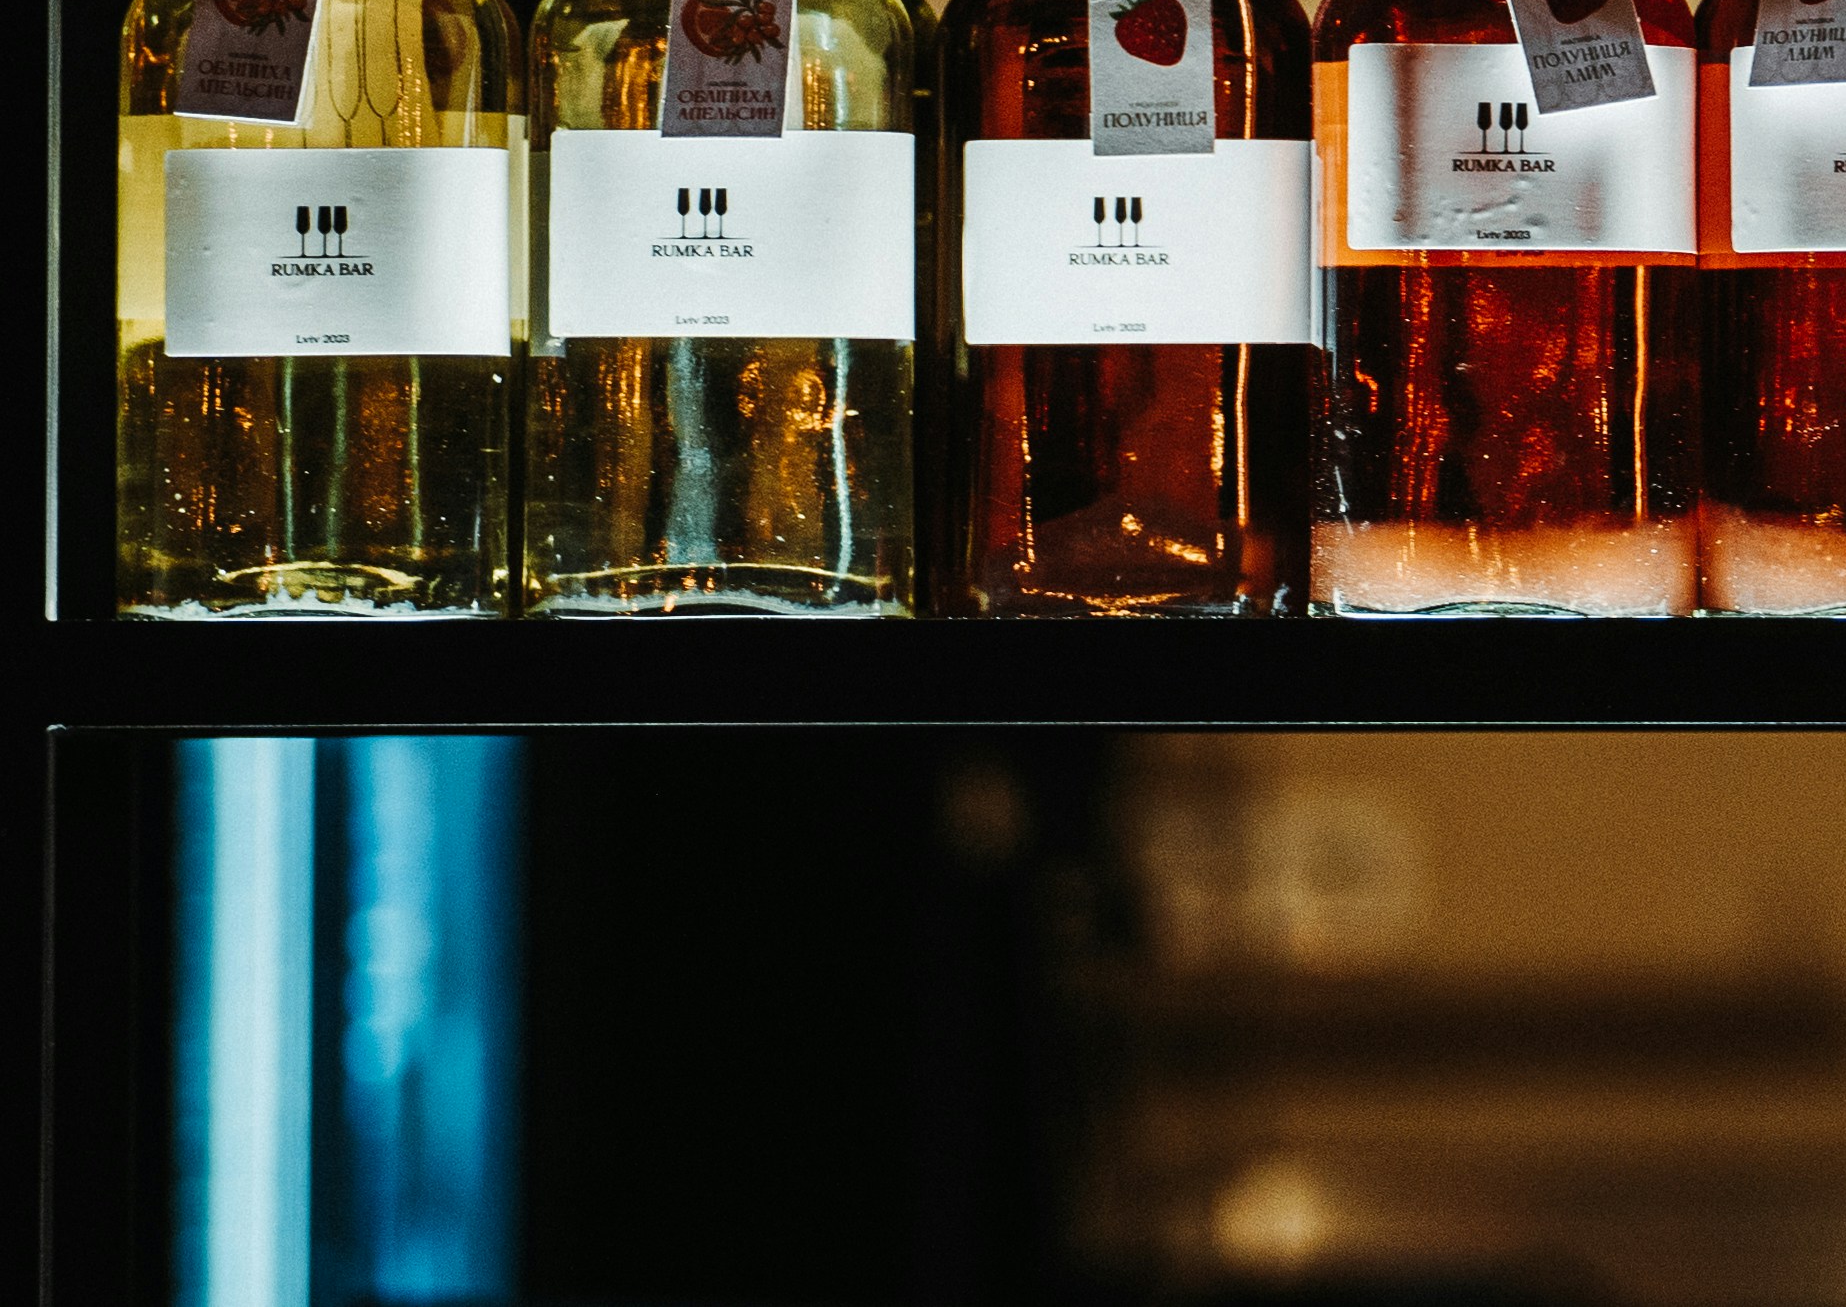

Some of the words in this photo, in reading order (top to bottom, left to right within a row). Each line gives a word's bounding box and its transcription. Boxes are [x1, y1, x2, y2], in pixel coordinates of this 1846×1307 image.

[1533, 41, 1632, 69] ПОЛУНИЦЯ
[1562, 62, 1616, 83] ЛАЙМ
[678, 106, 776, 120] АПЕЛЬСИН
[1103, 111, 1207, 128] ПОЛУНИЦЯ
[1452, 159, 1517, 172] RUMKA
[1520, 159, 1555, 172] BAR
[652, 245, 715, 257] RUMKA
[720, 245, 755, 257] BAR
[1069, 253, 1131, 265] RUMKA
[1136, 253, 1170, 265] BAR
[271, 263, 335, 276] RUMKA
[339, 262, 375, 275] BAR
